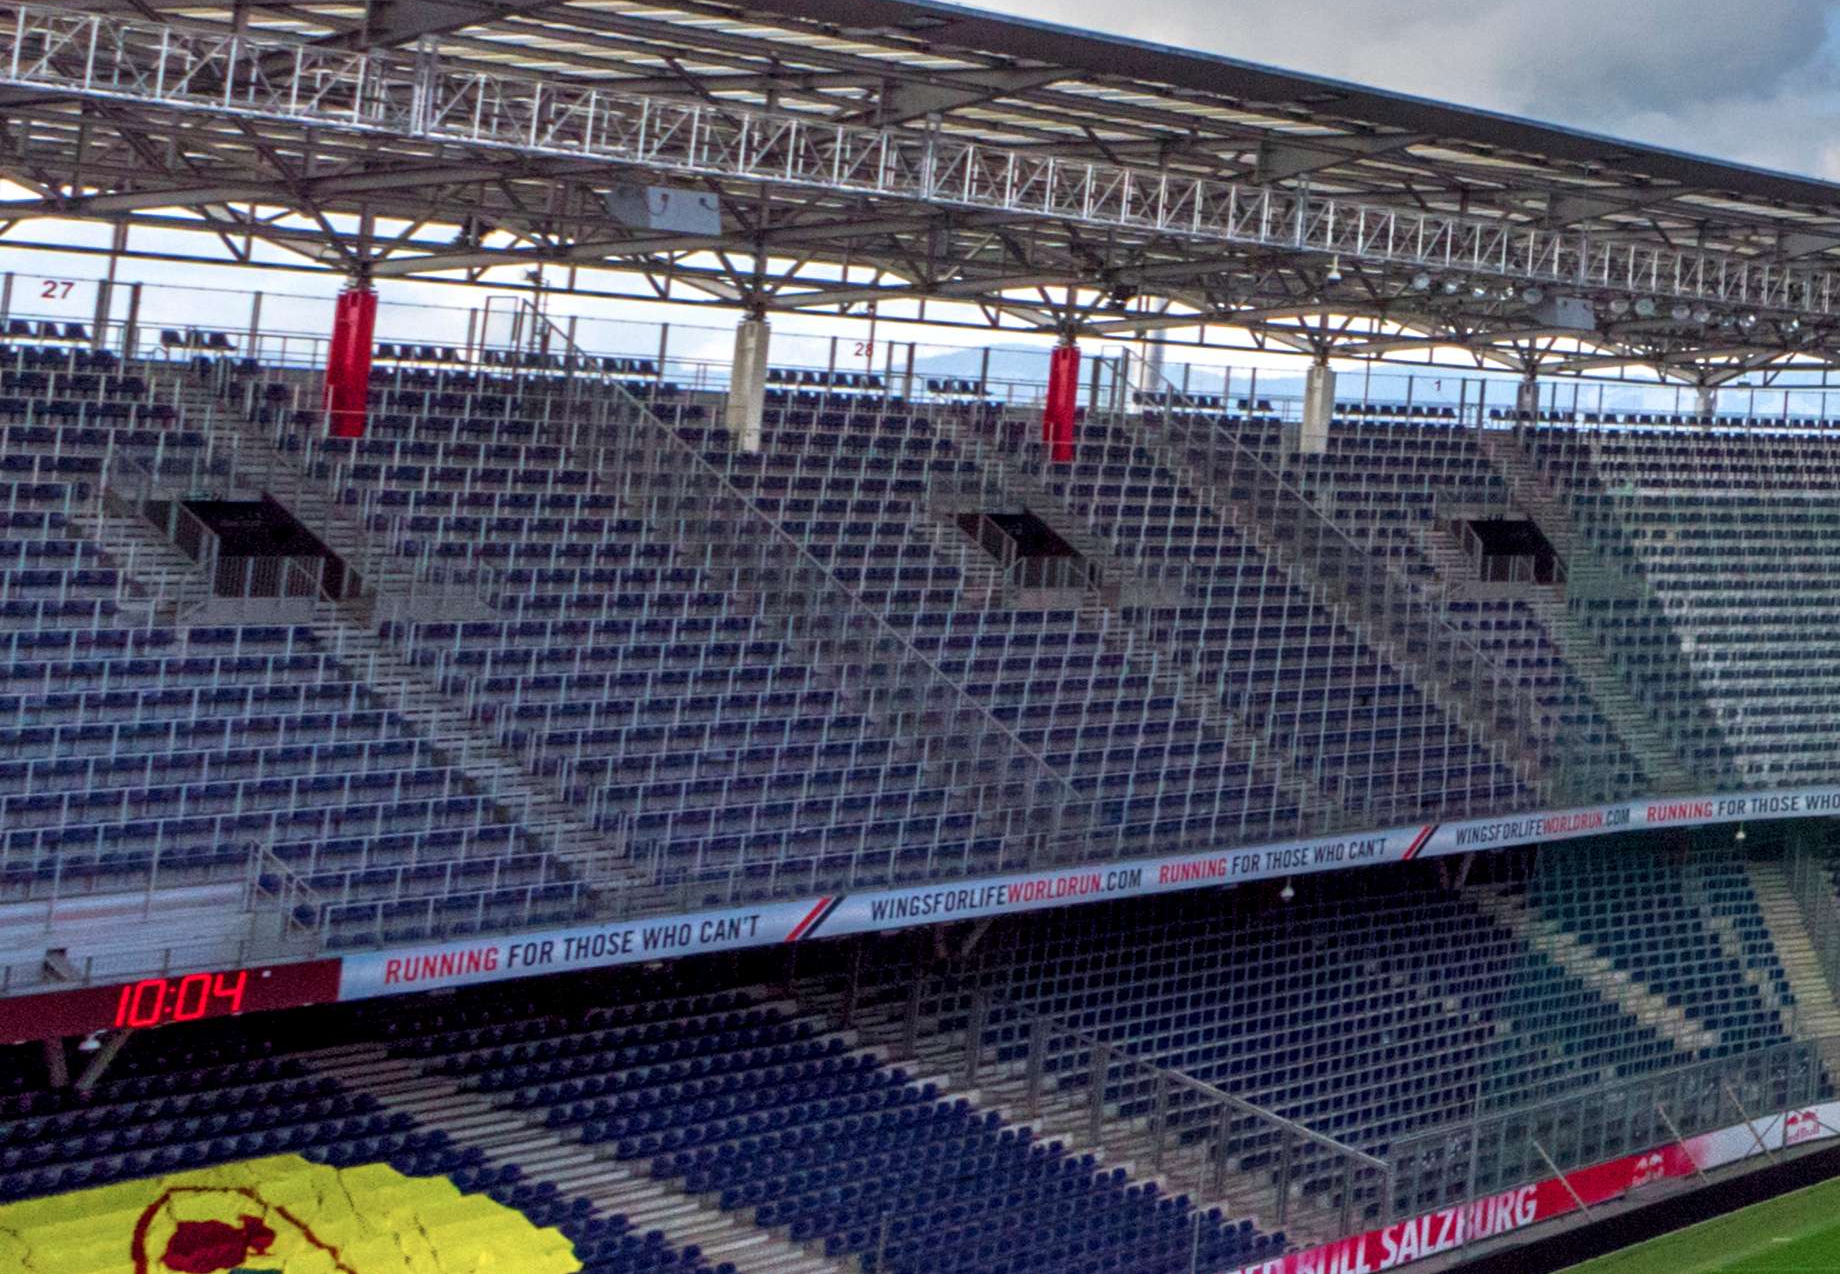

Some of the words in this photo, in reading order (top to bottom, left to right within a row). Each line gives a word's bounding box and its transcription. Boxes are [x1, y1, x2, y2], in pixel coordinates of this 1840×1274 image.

[41, 279, 75, 300] 27
[853, 341, 874, 358] 28
[1455, 807, 1631, 847] WINGSFORLIFEWORLDRUN.COM
[1646, 800, 1714, 822] RUNNING
[1717, 797, 1747, 818] FOR
[1750, 795, 1800, 816] THOSE
[870, 868, 1142, 922] WINGSFORLIFEWORLDRUN.COM
[1158, 857, 1227, 885] RUNNING
[1231, 853, 1262, 875] FOR
[1265, 846, 1309, 870] THOSE
[1312, 842, 1345, 865] WHO
[1347, 837, 1388, 860] CAN'T
[384, 946, 499, 986] RUNNING
[507, 940, 554, 969] FOR
[564, 929, 634, 963] THOSE
[641, 922, 692, 953] WHO
[699, 914, 762, 944] CAN'T
[114, 970, 248, 1028] 10:04
[1379, 1184, 1539, 1270] SALZBURG
